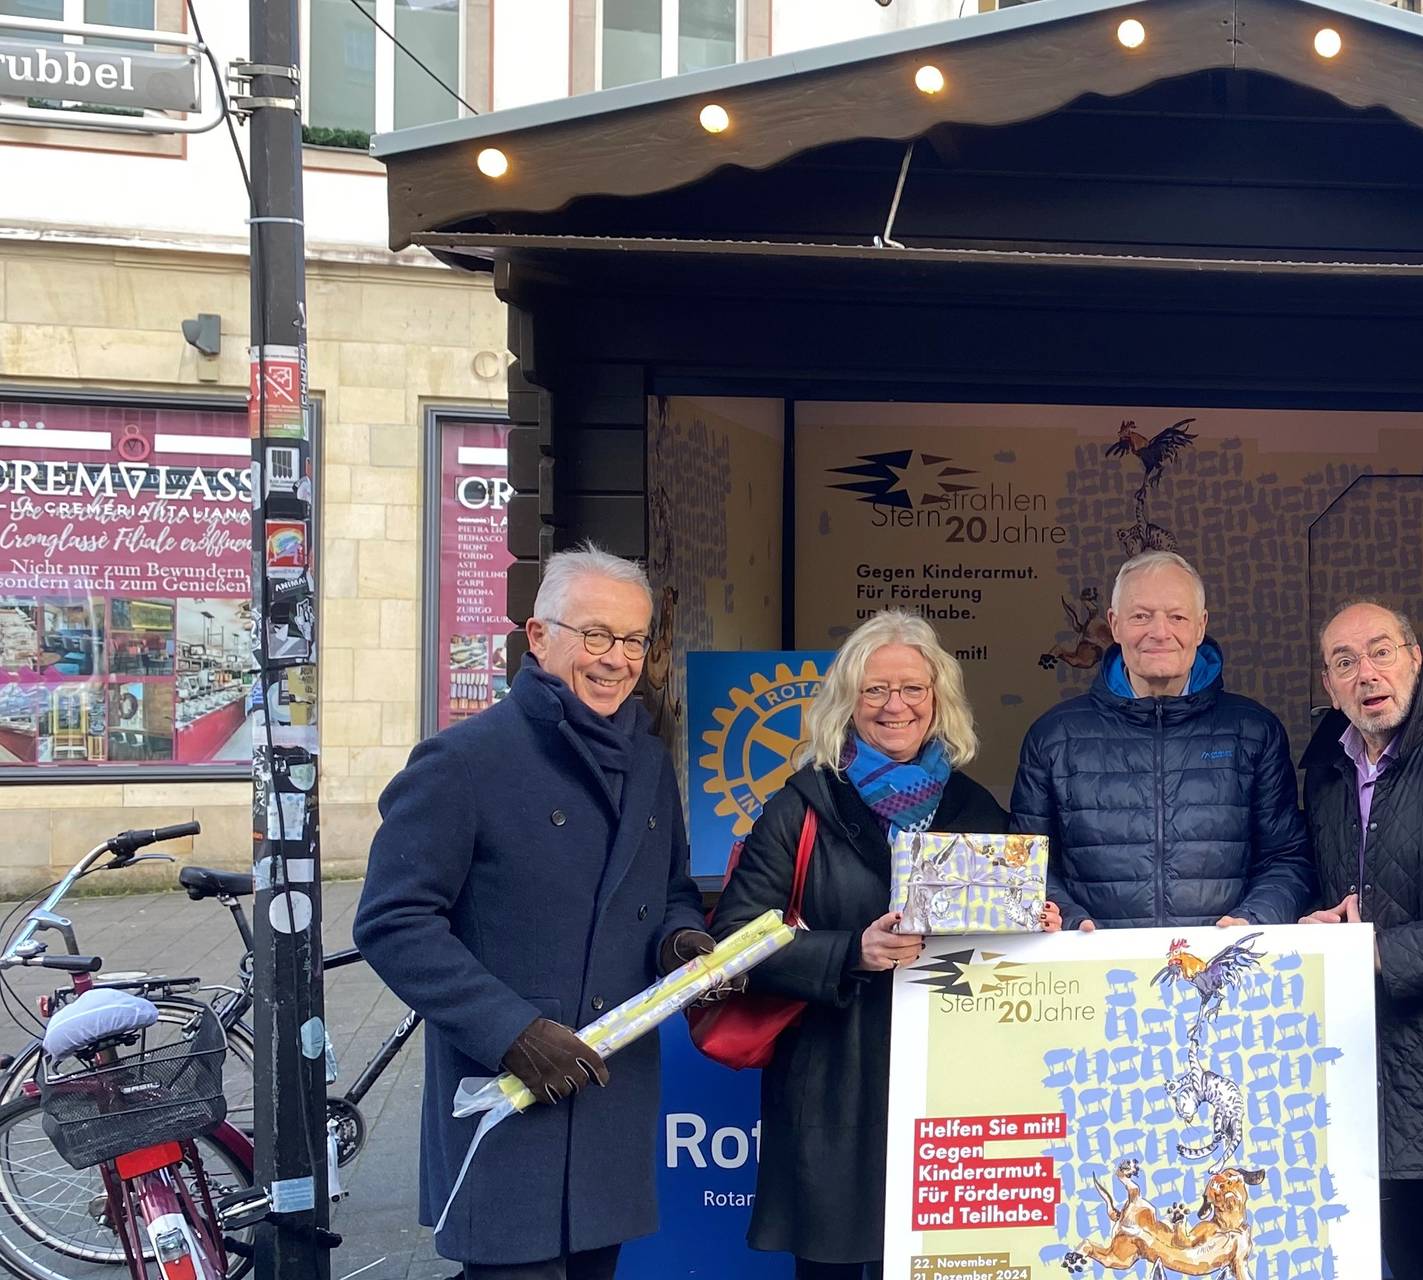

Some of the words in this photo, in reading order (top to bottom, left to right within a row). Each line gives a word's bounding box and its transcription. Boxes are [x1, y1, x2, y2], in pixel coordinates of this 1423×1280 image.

[940, 482, 1048, 512] strahlen
[11, 502, 33, 513] LA
[160, 505, 251, 521] ITALIANA
[945, 516, 988, 543] 20
[990, 514, 1067, 544] Jahre
[113, 525, 177, 554] Filiale
[457, 553, 494, 561] TORINO
[457, 562, 477, 570] ASTI
[11, 559, 63, 576] Nicht
[68, 563, 99, 575] nur
[104, 565, 141, 576] zum
[147, 562, 250, 581] Bewundern,
[856, 564, 915, 583] Gegen
[922, 562, 1039, 580] Kinderarmut.
[74, 575, 115, 591] auch
[119, 579, 157, 591] zum
[456, 579, 485, 588] CARPI
[456, 588, 494, 597] VERONA
[856, 585, 884, 599] Für
[891, 584, 982, 603] Förderung
[456, 606, 492, 615] ZURIGO
[456, 615, 480, 623] NOVI
[481, 616, 512, 624] LIGUR
[955, 645, 988, 660] mit!
[994, 971, 1080, 998] strahlen
[998, 1000, 1032, 1023] 20
[1033, 998, 1096, 1023] Jahre
[919, 1119, 984, 1139] Helfen
[988, 1118, 1019, 1136] Sie
[1023, 1116, 1061, 1135] mit!
[919, 1143, 984, 1163] Gegen
[918, 1162, 1048, 1182] Kinderarmut.
[918, 1186, 949, 1204] Für
[954, 1183, 1056, 1204] Förderung
[917, 1206, 954, 1226] und
[959, 1203, 1049, 1224] Teilhabe.
[914, 1258, 934, 1269] 22.
[937, 1256, 998, 1269] November
[933, 1271, 994, 1280] Dezember
[996, 1269, 1028, 1280] 2024
